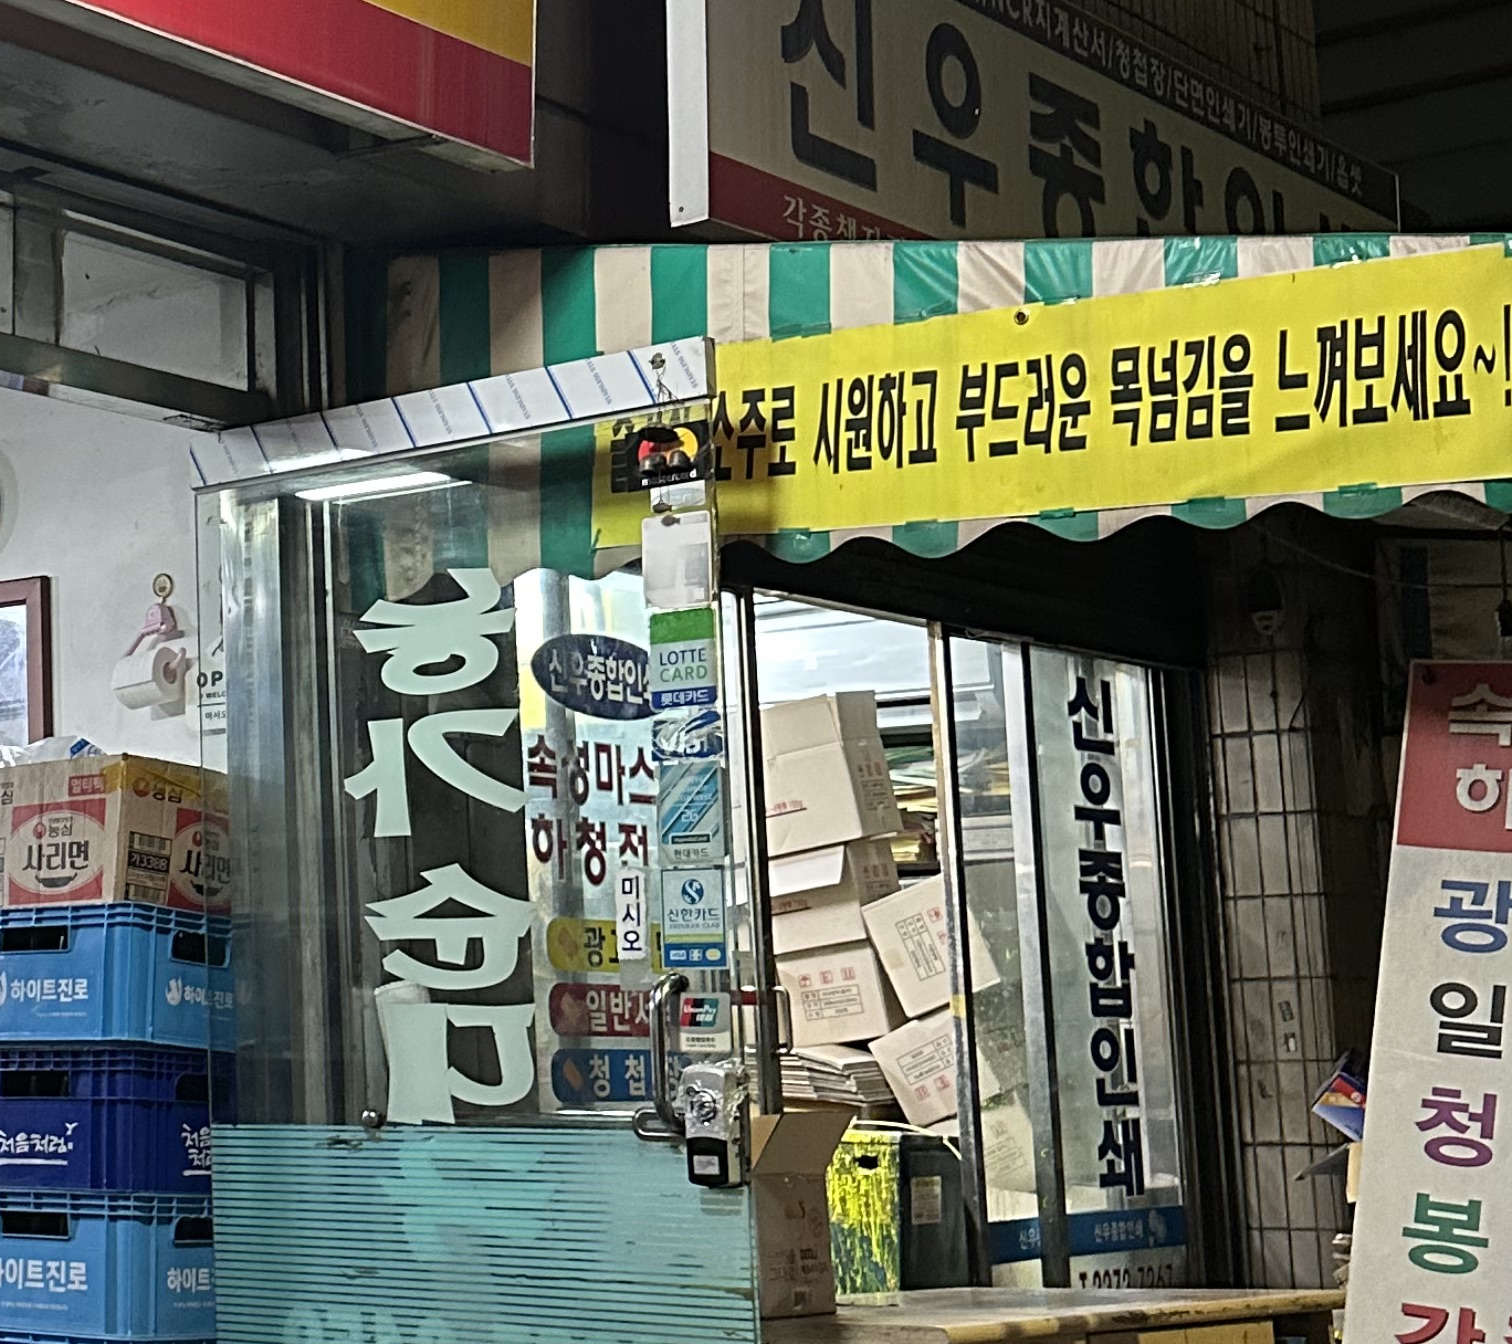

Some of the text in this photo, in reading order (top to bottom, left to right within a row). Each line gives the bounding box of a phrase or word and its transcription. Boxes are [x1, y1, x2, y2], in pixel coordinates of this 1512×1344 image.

[812, 367, 938, 476] 시원하고
[955, 351, 1089, 462] 부드러운
[1109, 331, 1254, 447] 목넘김을
[659, 648, 708, 666] LOTTE
[549, 648, 652, 705] 신우종합인
[660, 665, 708, 683] CARD
[660, 689, 710, 706] 롯데카드
[48, 823, 73, 839] 농심
[21, 840, 90, 872] 사리면
[621, 875, 643, 952] 미시오
[667, 908, 721, 923] 신한카드
[1067, 676, 1146, 1198] 신우종합인쇄
[10, 977, 88, 1003] 하이트진로
[1429, 980, 1506, 1060] 일
[1416, 1086, 1498, 1168] 청
[1402, 1191, 1489, 1275] 봉
[167, 1267, 213, 1294] 하이트
